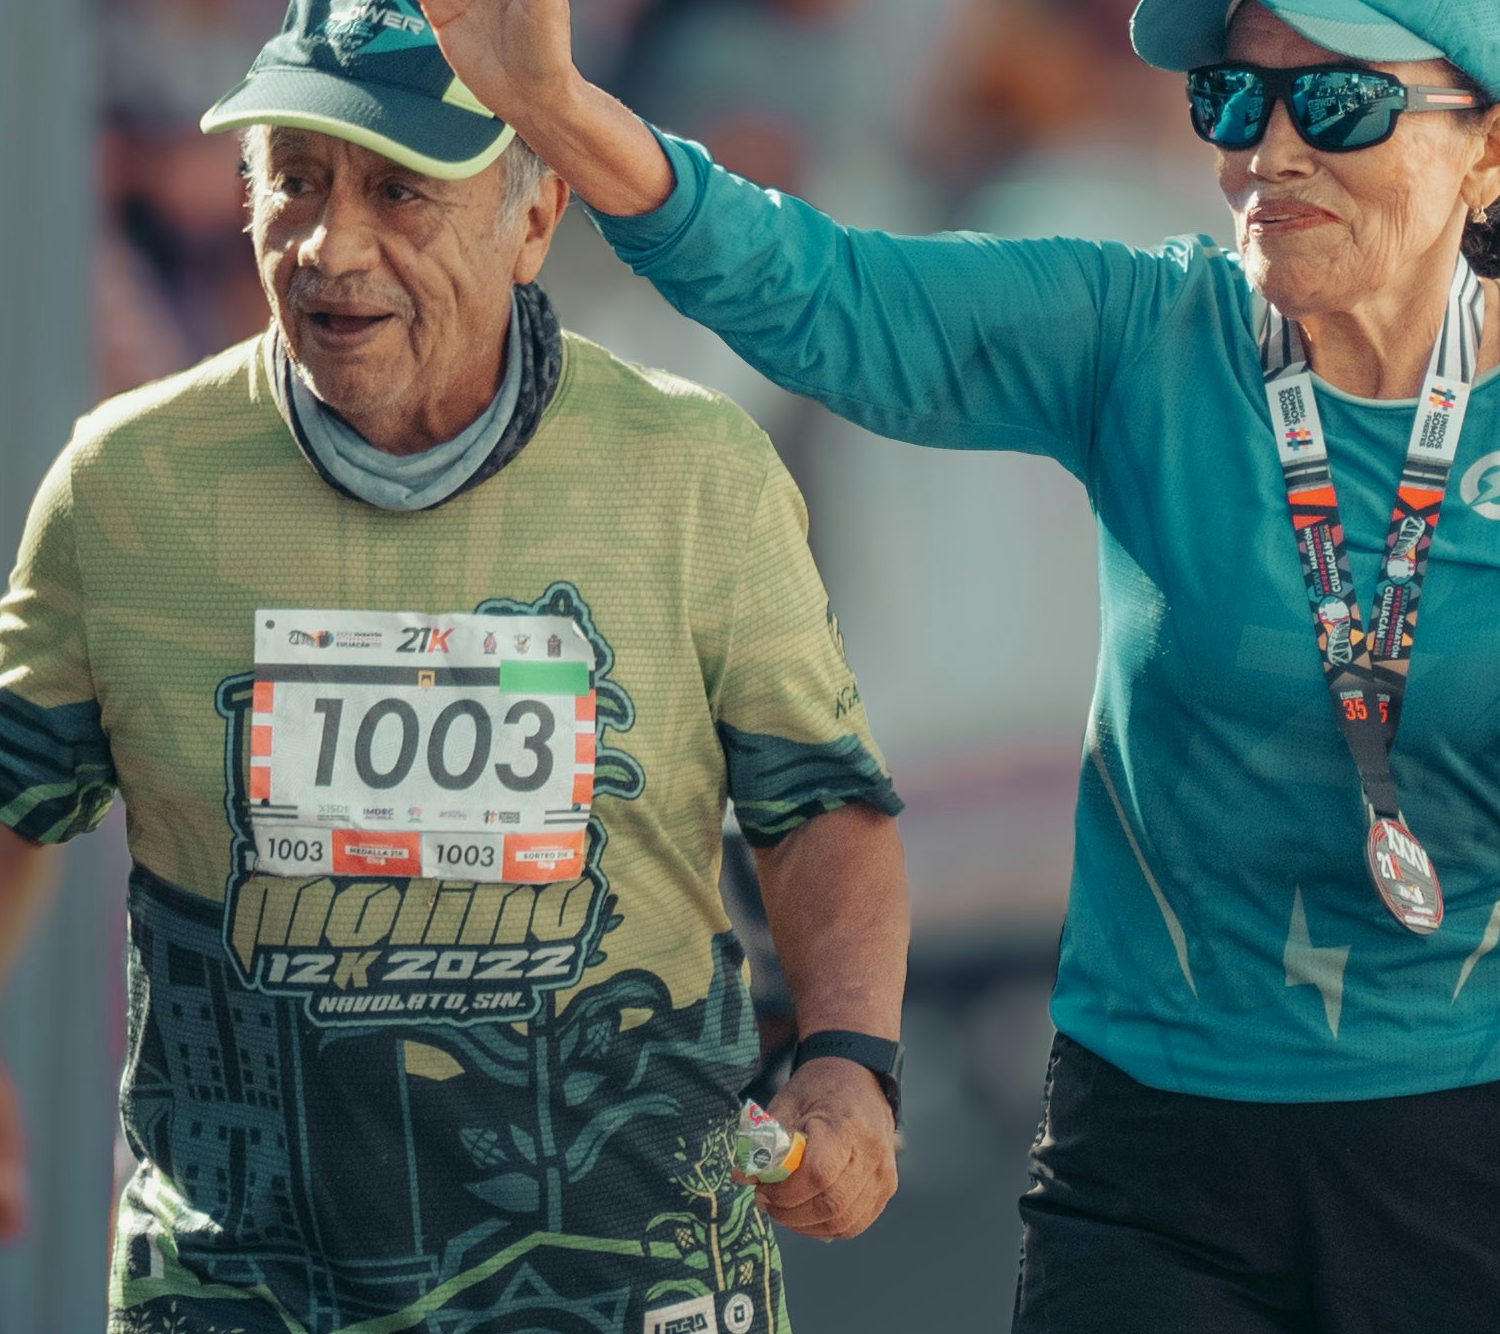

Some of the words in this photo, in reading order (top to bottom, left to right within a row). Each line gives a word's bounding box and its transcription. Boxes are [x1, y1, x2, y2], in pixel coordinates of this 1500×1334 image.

[1278, 390, 1292, 427] UNIDOS
[1286, 387, 1301, 425] SOMOS
[1419, 414, 1432, 447] FUERTES
[1426, 412, 1442, 449] SOMOS
[1434, 414, 1449, 450] UNIDOS
[1304, 527, 1319, 570] MARATÓN
[1322, 541, 1342, 593] CULIACÁN
[1376, 586, 1394, 639] CULIACÁN
[396, 627, 456, 654] 21K
[1391, 614, 1405, 659] MARATÓN
[1342, 698, 1369, 721] 35
[312, 697, 556, 793] 1003
[362, 807, 395, 817] IMDEC
[268, 838, 324, 862] 1003
[349, 848, 389, 857] MEDALLA
[436, 844, 495, 867] 1003
[523, 852, 555, 860] SORTEO
[380, 945, 577, 982] 2022
[318, 993, 470, 1014] NAVOLATO,
[471, 991, 527, 1010] SIN.
